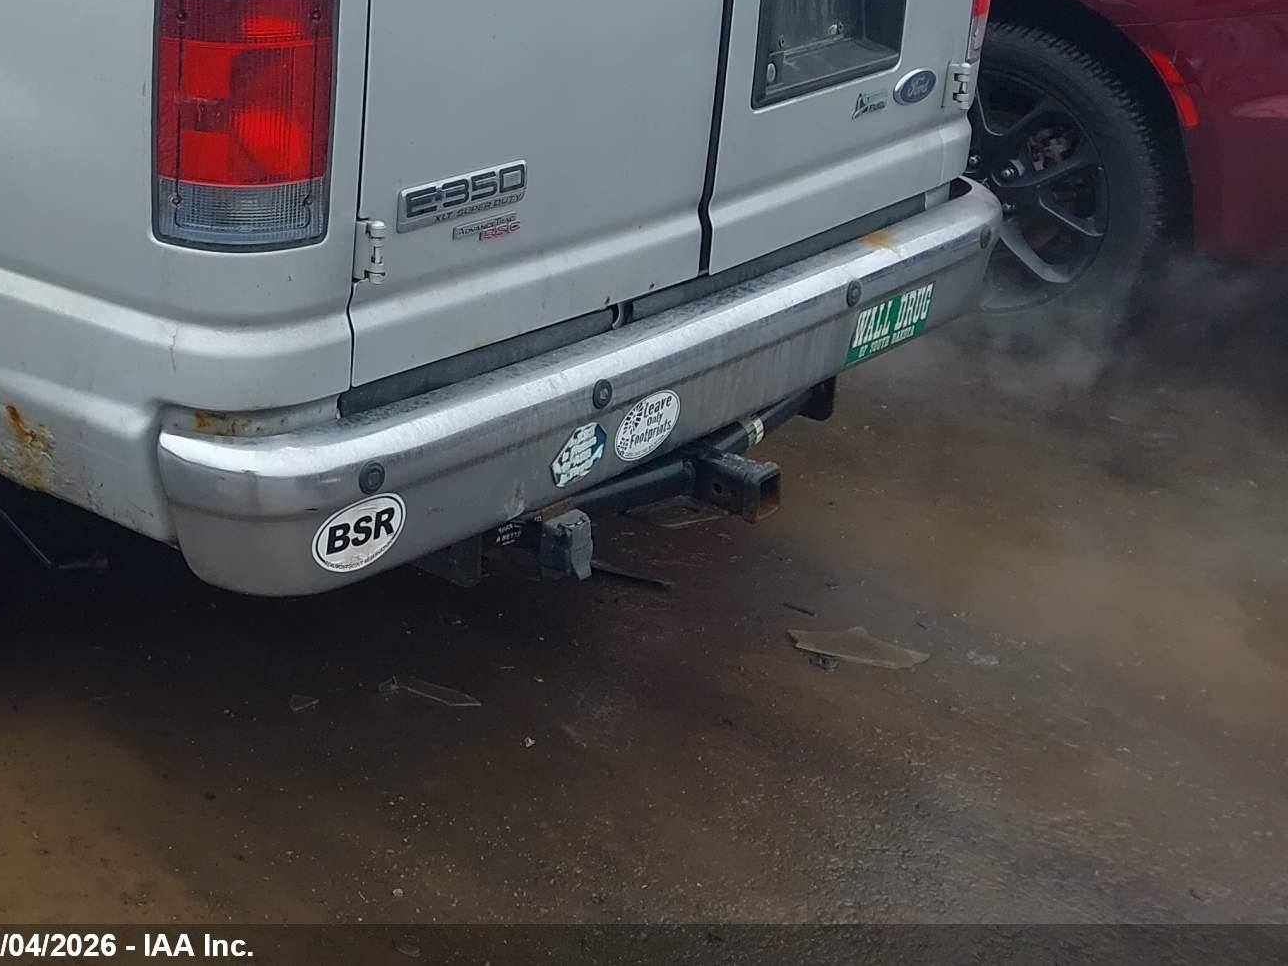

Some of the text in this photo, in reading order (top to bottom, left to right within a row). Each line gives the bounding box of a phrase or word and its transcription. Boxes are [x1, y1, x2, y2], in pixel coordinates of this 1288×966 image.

[434, 193, 522, 224] XLT SUPER DUTY
[852, 283, 933, 348] WALL DRUG
[643, 395, 672, 419] Leave
[646, 412, 663, 427] Only
[629, 418, 672, 450] Footprints
[326, 507, 395, 555] BSR
